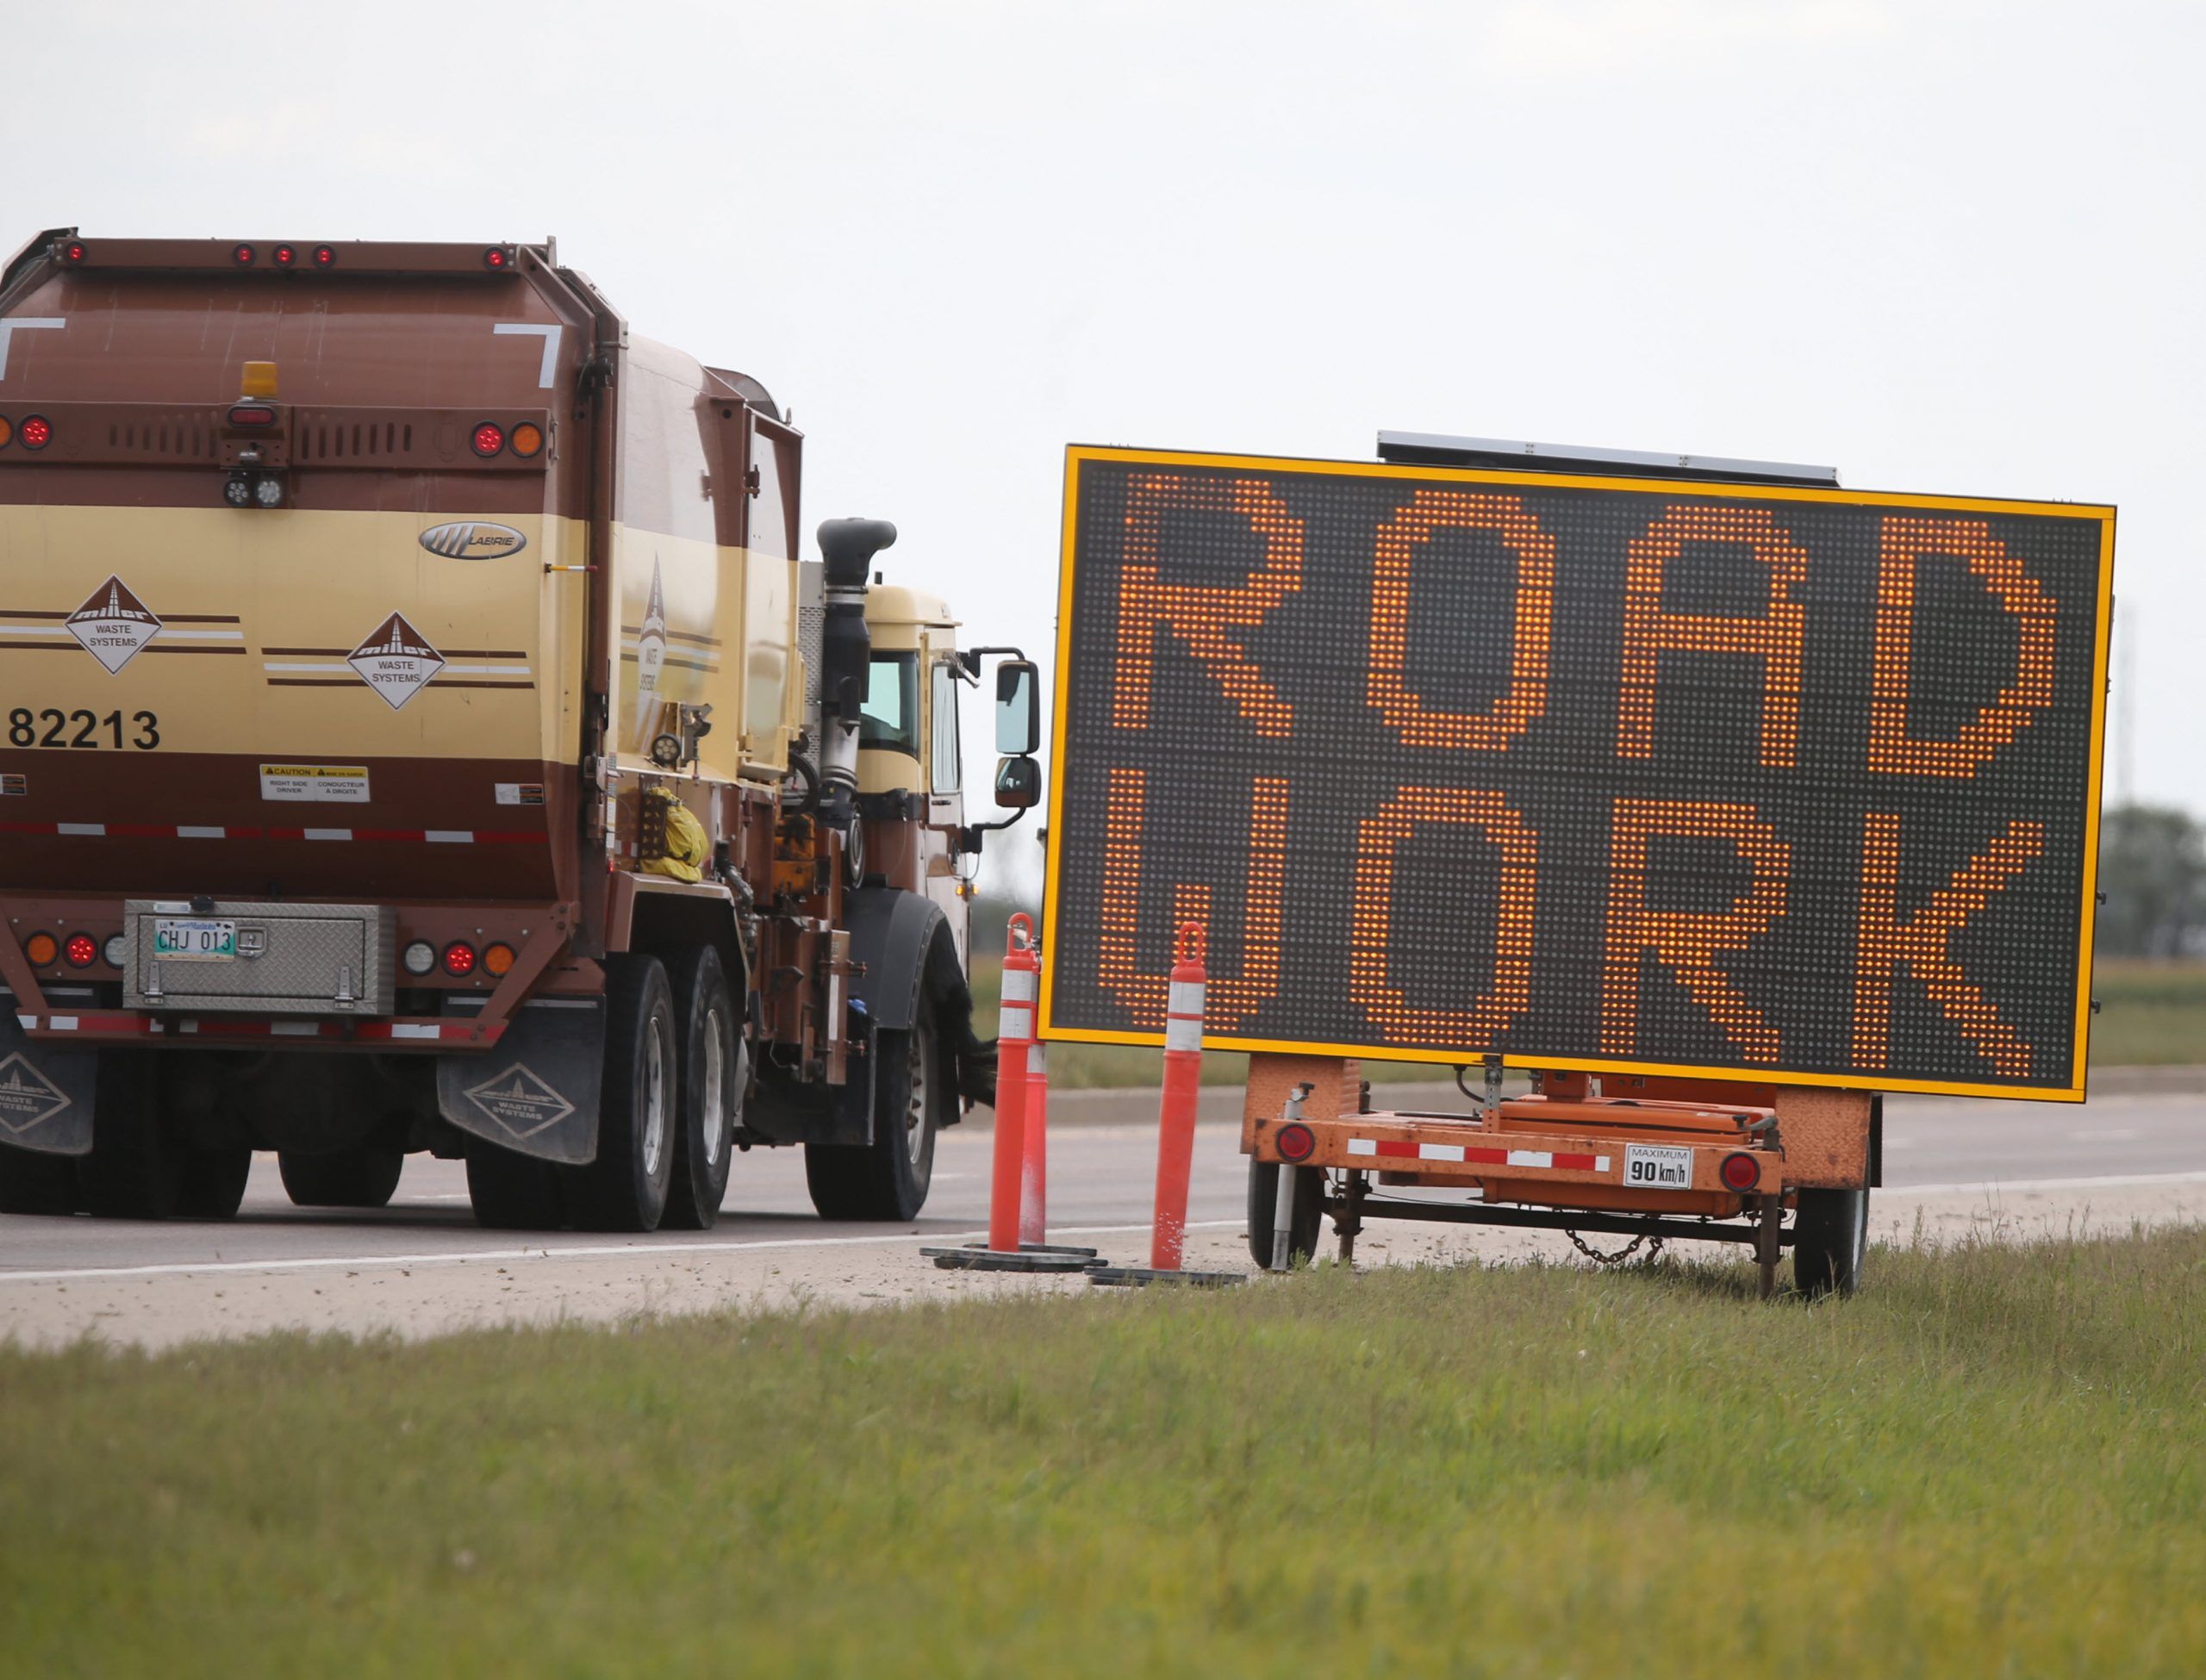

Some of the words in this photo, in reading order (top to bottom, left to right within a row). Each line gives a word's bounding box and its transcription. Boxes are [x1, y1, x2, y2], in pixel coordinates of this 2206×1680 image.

[468, 537, 514, 546] LABRIE
[96, 625, 131, 634] WASTE
[1112, 473, 2058, 778] ROAD
[90, 638, 137, 647] SYSTEMS
[377, 661, 414, 670] WASTE
[371, 673, 421, 682] SYSTEMS
[9, 707, 160, 750] 82213
[1096, 767, 2045, 1077] WORK
[159, 930, 189, 949] CHJ
[201, 931, 231, 950] 013
[492, 1106, 543, 1120] SYSTEMS
[498, 1102, 536, 1112] WASTE
[1631, 1148, 1688, 1160] MAXIMUM
[1630, 1160, 1656, 1181] 90
[1658, 1162, 1686, 1185] km/h
